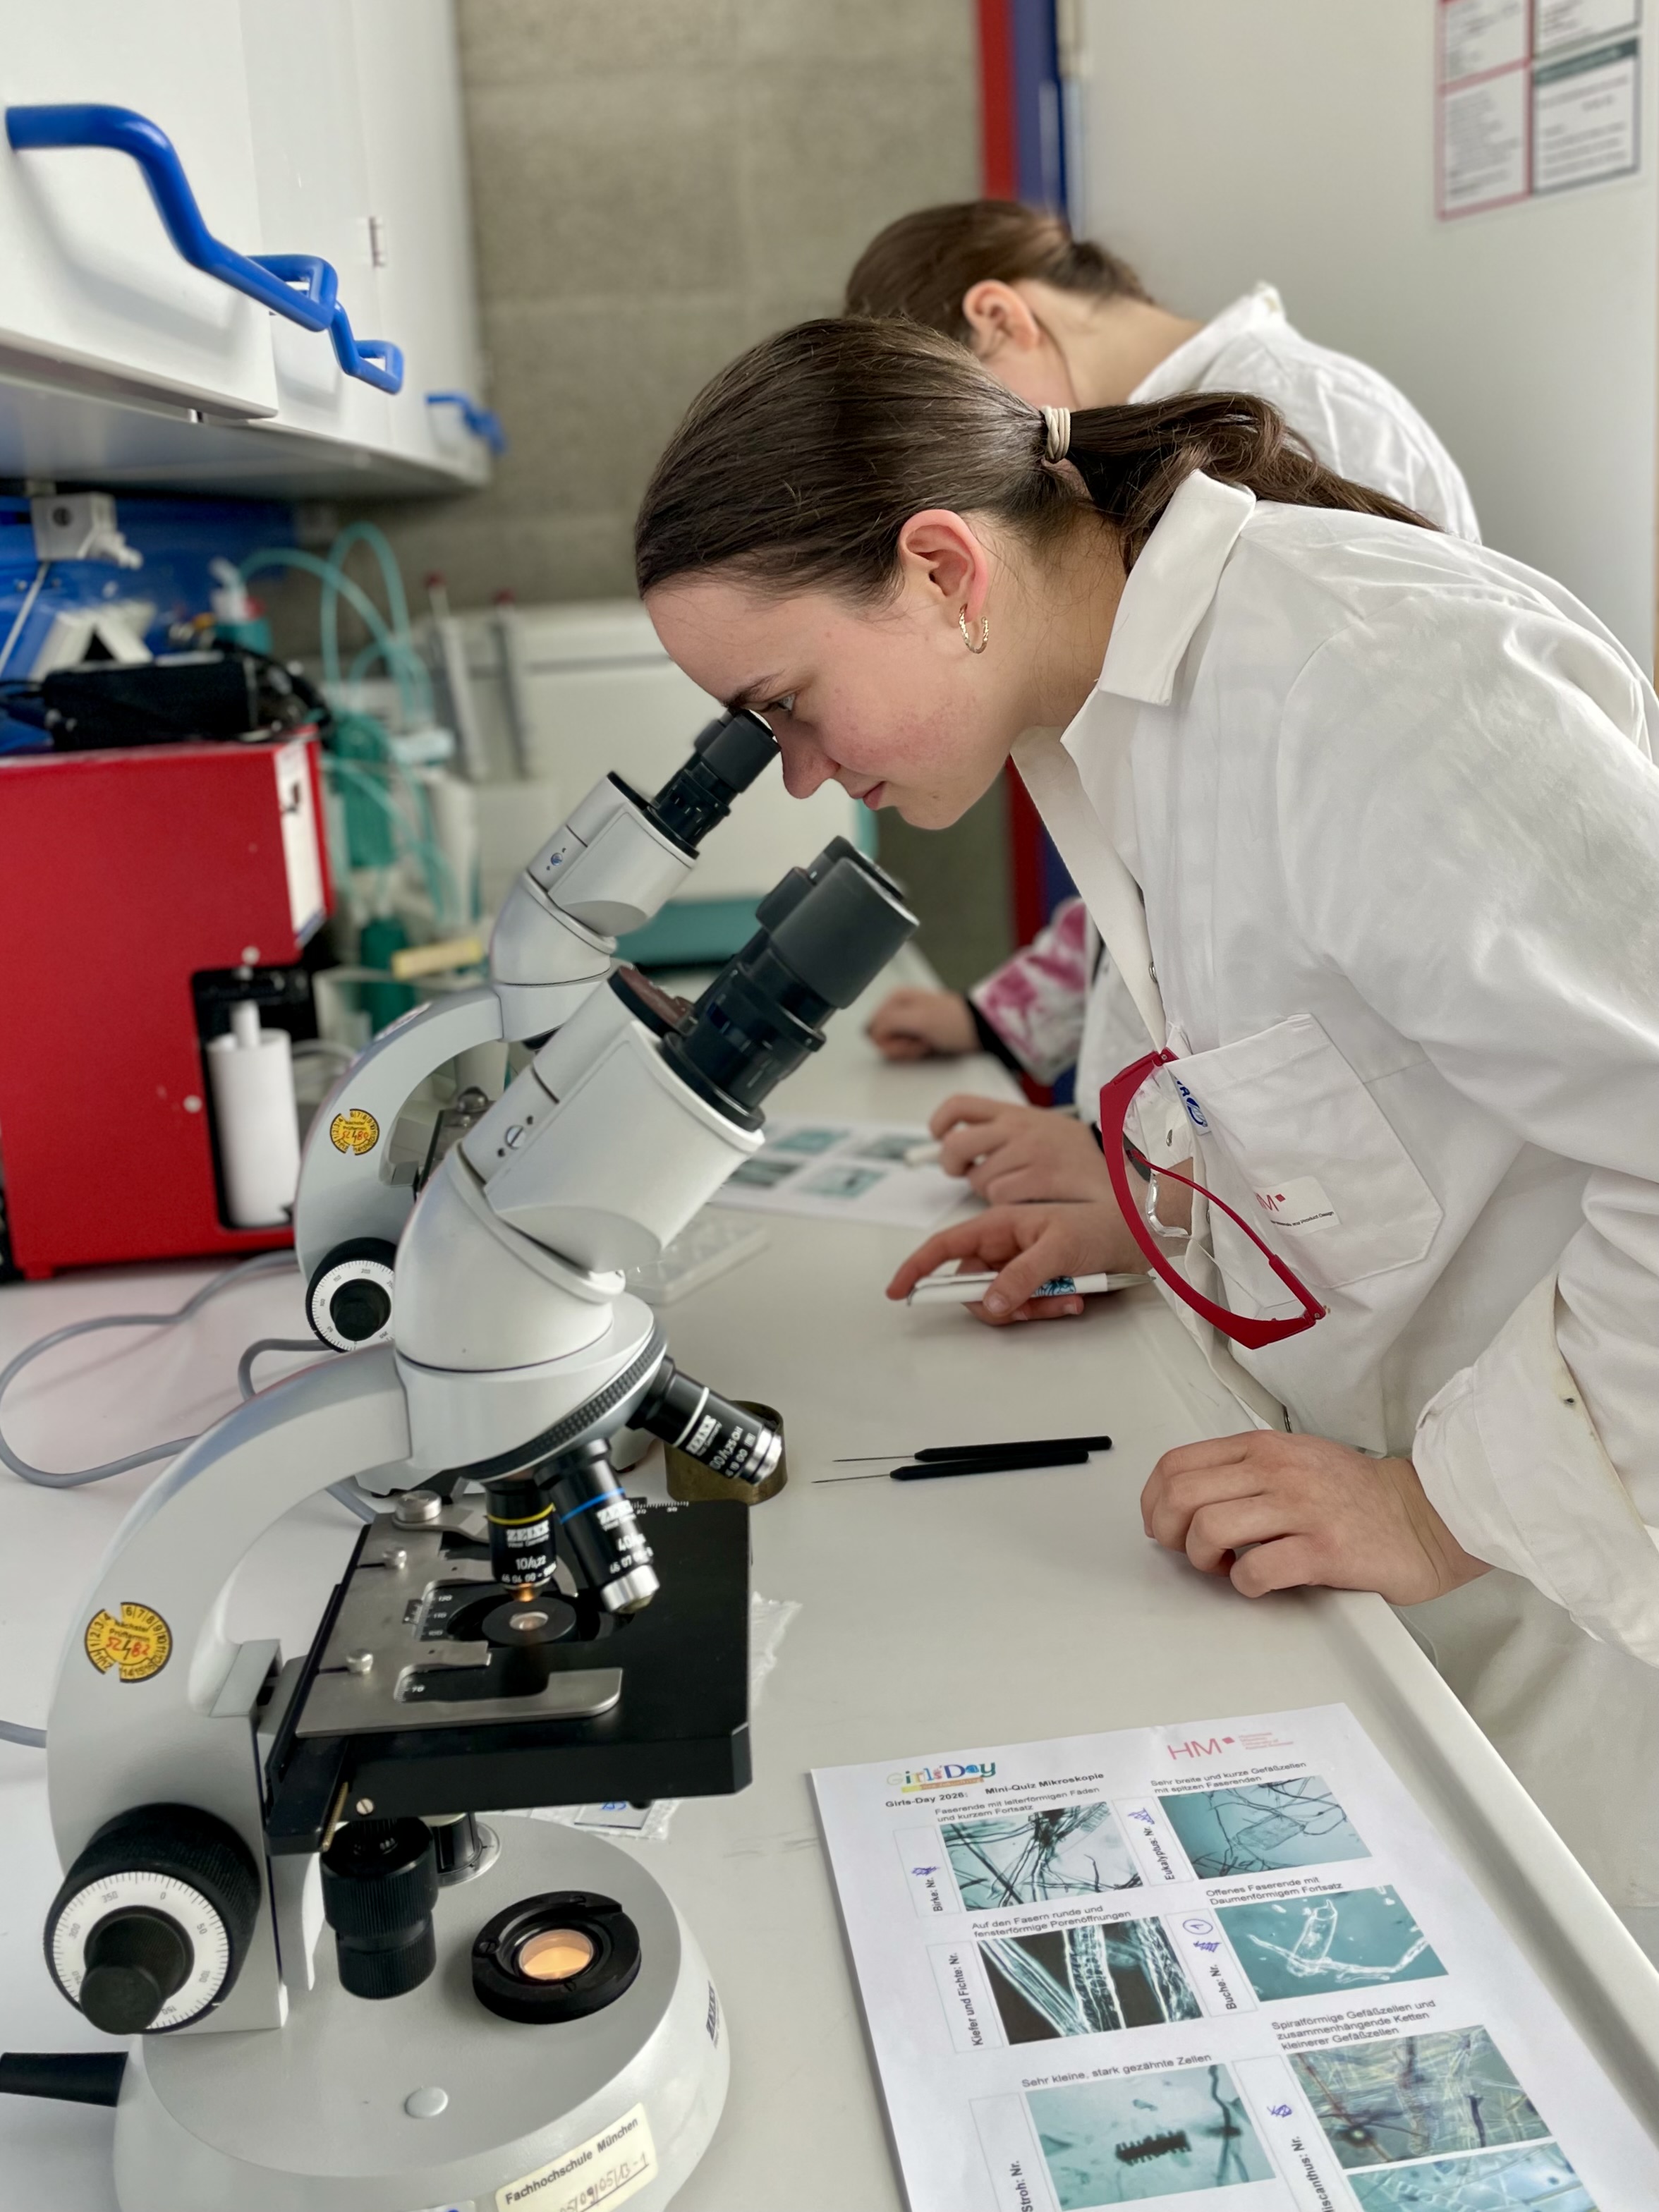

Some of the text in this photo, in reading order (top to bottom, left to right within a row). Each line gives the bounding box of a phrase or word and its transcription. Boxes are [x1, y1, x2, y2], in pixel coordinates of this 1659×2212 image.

[506, 1519, 549, 1543] ZEISS
[1167, 1738, 1222, 1761] HM
[1171, 1784, 1205, 1794] spitzen
[1207, 1776, 1263, 1789] Faserenden
[1175, 1776, 1202, 1785] breite
[1224, 1770, 1249, 1779] kurze
[1251, 1762, 1307, 1775] Gefäßzellen
[885, 1796, 936, 1808] Girls-Day
[985, 1783, 1036, 1795] Mini-Quiz
[1039, 1773, 1105, 1788] Mikroskopie
[935, 1803, 985, 1816] Faserende
[988, 1799, 1003, 1808] mit
[957, 1811, 992, 1821] kurzem
[995, 1804, 1034, 1816] Fortsatz
[1149, 1837, 1176, 1881] Eukalyptus:
[101, 1890, 119, 1904] 350
[159, 1892, 166, 1900] 0
[930, 1889, 944, 1912] Birke:
[1206, 1887, 1246, 1897] Offenes
[1247, 1879, 1301, 1892] Faserende
[1210, 1883, 1344, 1905] Daumenförmigem Fortsatz
[197, 1922, 208, 1935] 50
[972, 1905, 1104, 1930] Auf den Fasern runde und
[974, 1911, 1131, 1938] fensterförmige Porenöffnungen
[948, 1952, 984, 2046] Kiefer und Fichte: Nr.
[1210, 1964, 1237, 2010] Buche: Nr.
[1272, 2000, 1436, 2031] Spiralförmige Gefäßzellen und
[1277, 2012, 1430, 2041] zusammenhängende Ketten
[1281, 2026, 1399, 2051] kleinerer Gefäßzellen
[1021, 2053, 1213, 2088] Sehr kleine, stark gezähnte Zellen
[504, 2117, 638, 2206] Fachhochschule München
[1292, 2136, 1335, 2212] iscanthus: Nr.
[1009, 2160, 1033, 2212] Stroh: Nr.
